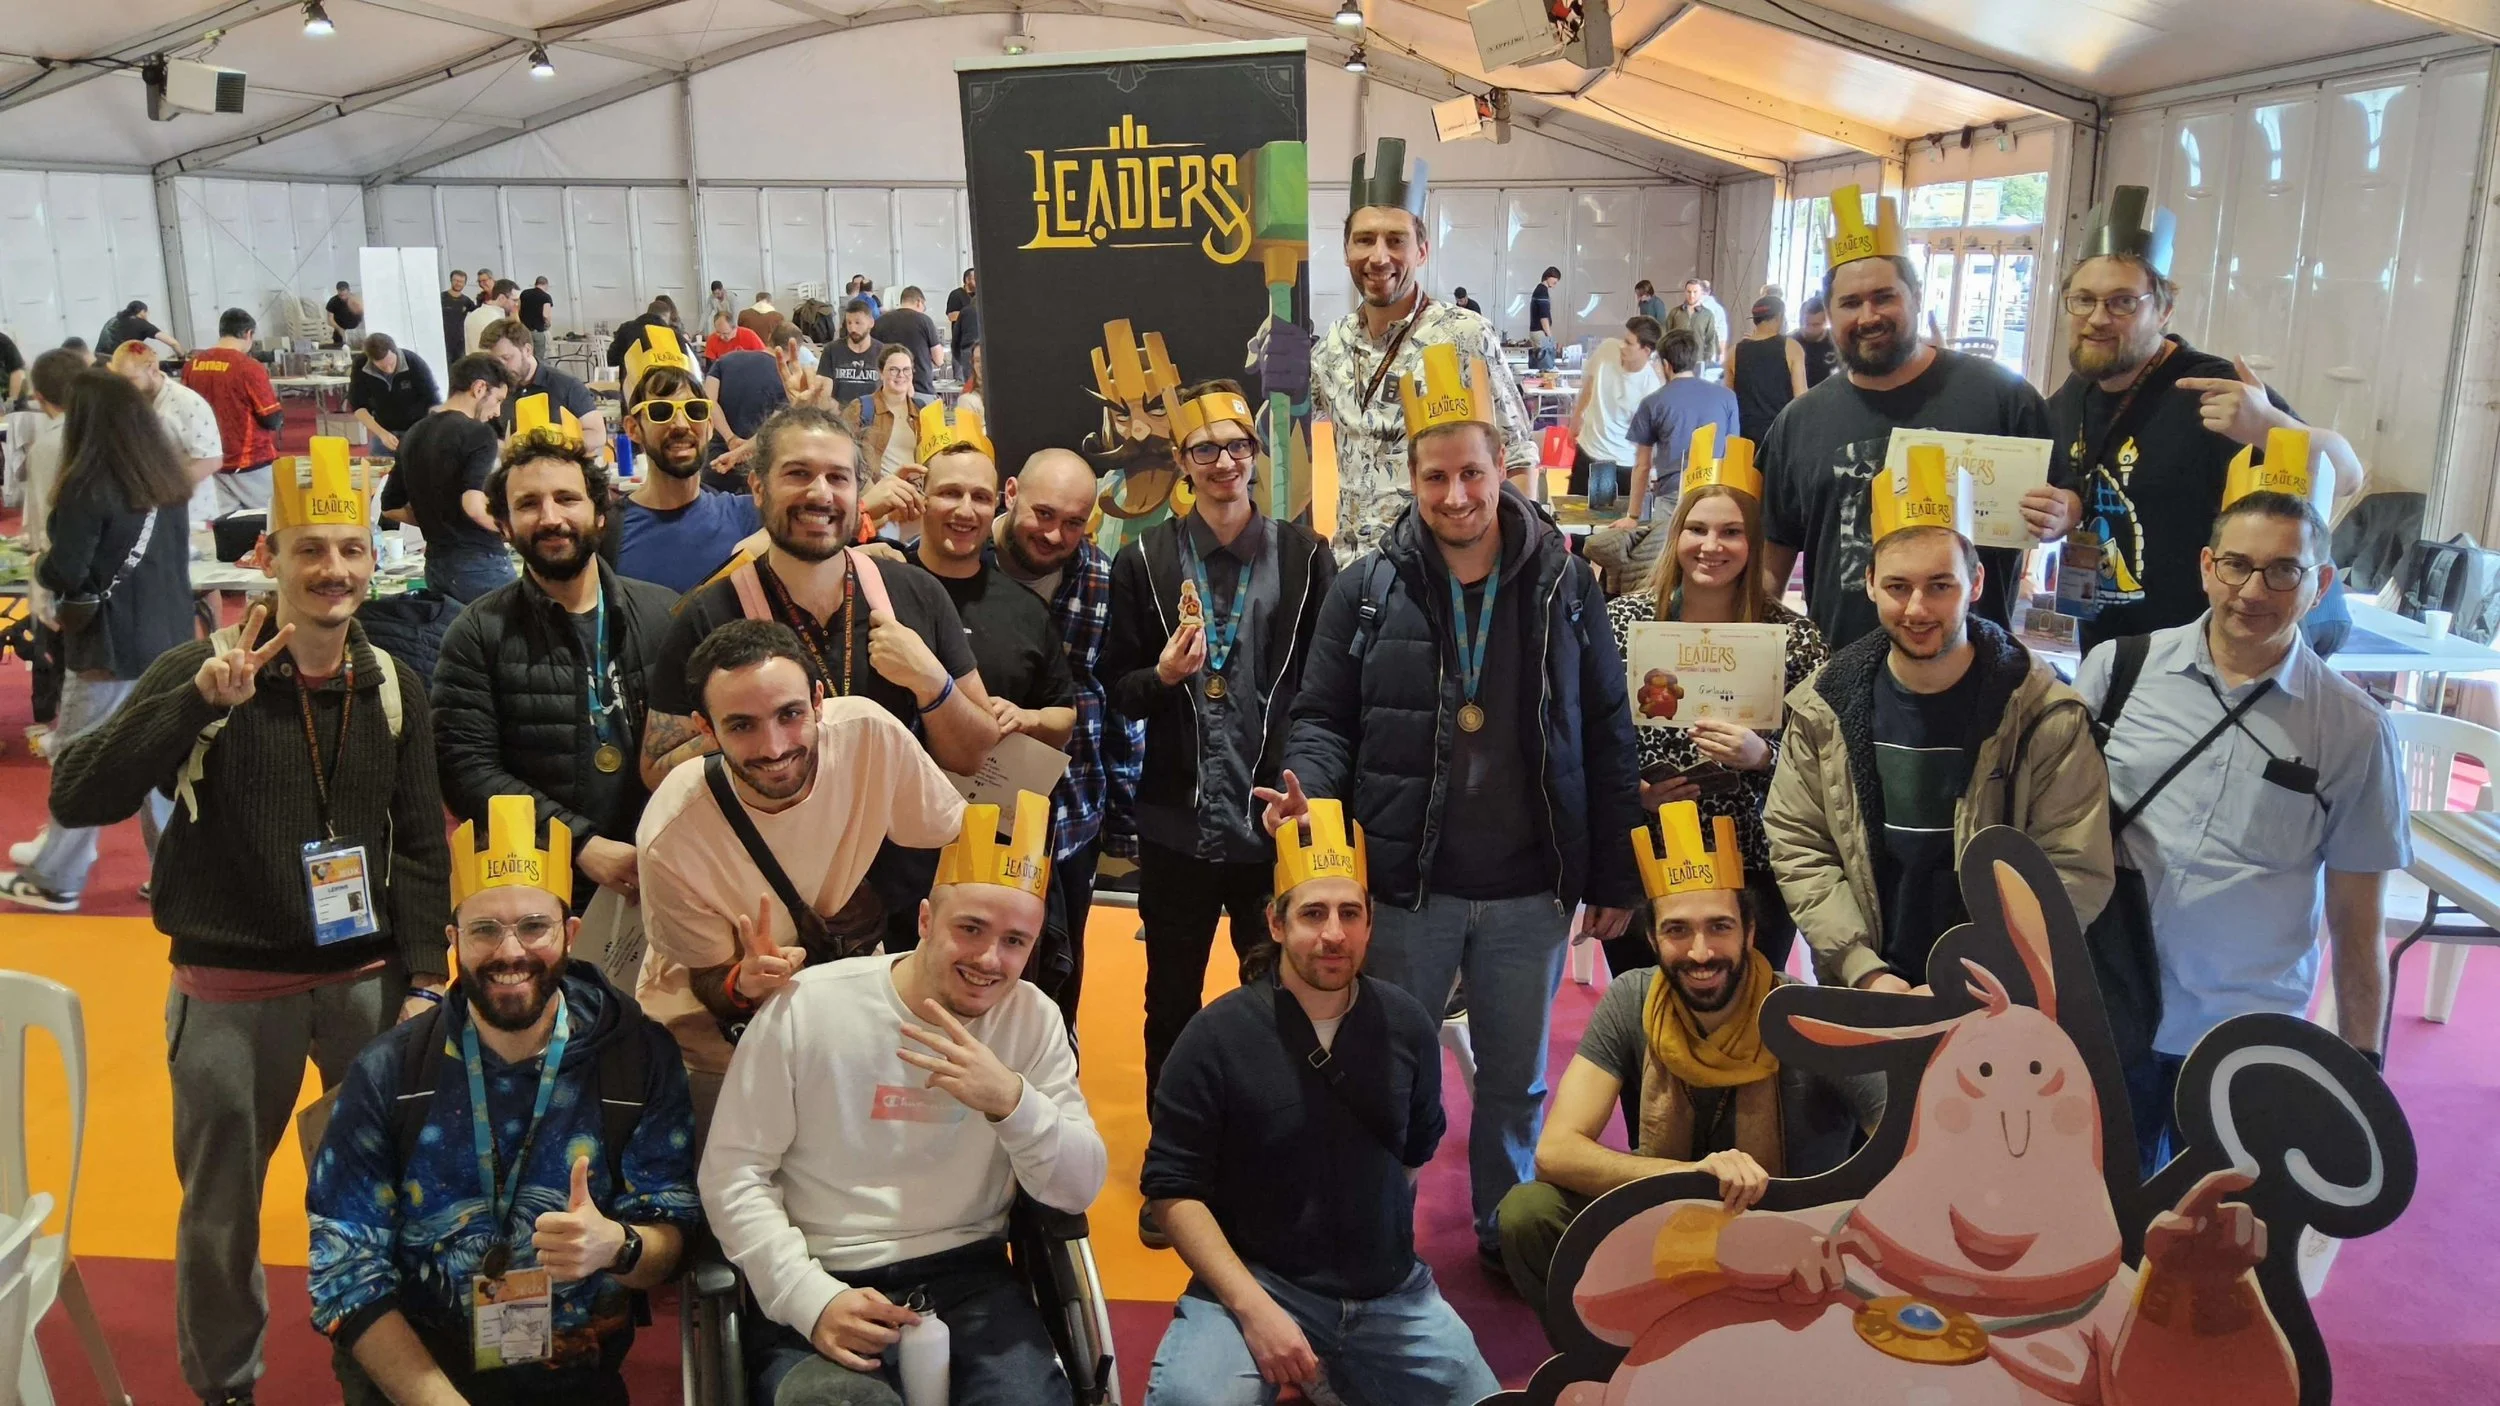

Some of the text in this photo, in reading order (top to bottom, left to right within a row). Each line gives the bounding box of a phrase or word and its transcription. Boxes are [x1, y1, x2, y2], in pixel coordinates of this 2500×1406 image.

[1017, 149, 1252, 265] LEADERS
[1834, 235, 1873, 257] LEADERS
[835, 367, 880, 382] IRELAND
[1427, 398, 1469, 419] LEADERS
[1945, 456, 1996, 486] EADERS
[2259, 472, 2308, 496] LEADERS
[312, 498, 357, 520] LEADERS
[1904, 501, 1951, 524] LEADERS
[1676, 642, 1737, 672] LEADERS
[486, 859, 540, 882] LEADERS
[1002, 856, 1043, 889] LEADERS
[1312, 853, 1353, 874] LEADERS
[1667, 864, 1714, 885] LEADERS
